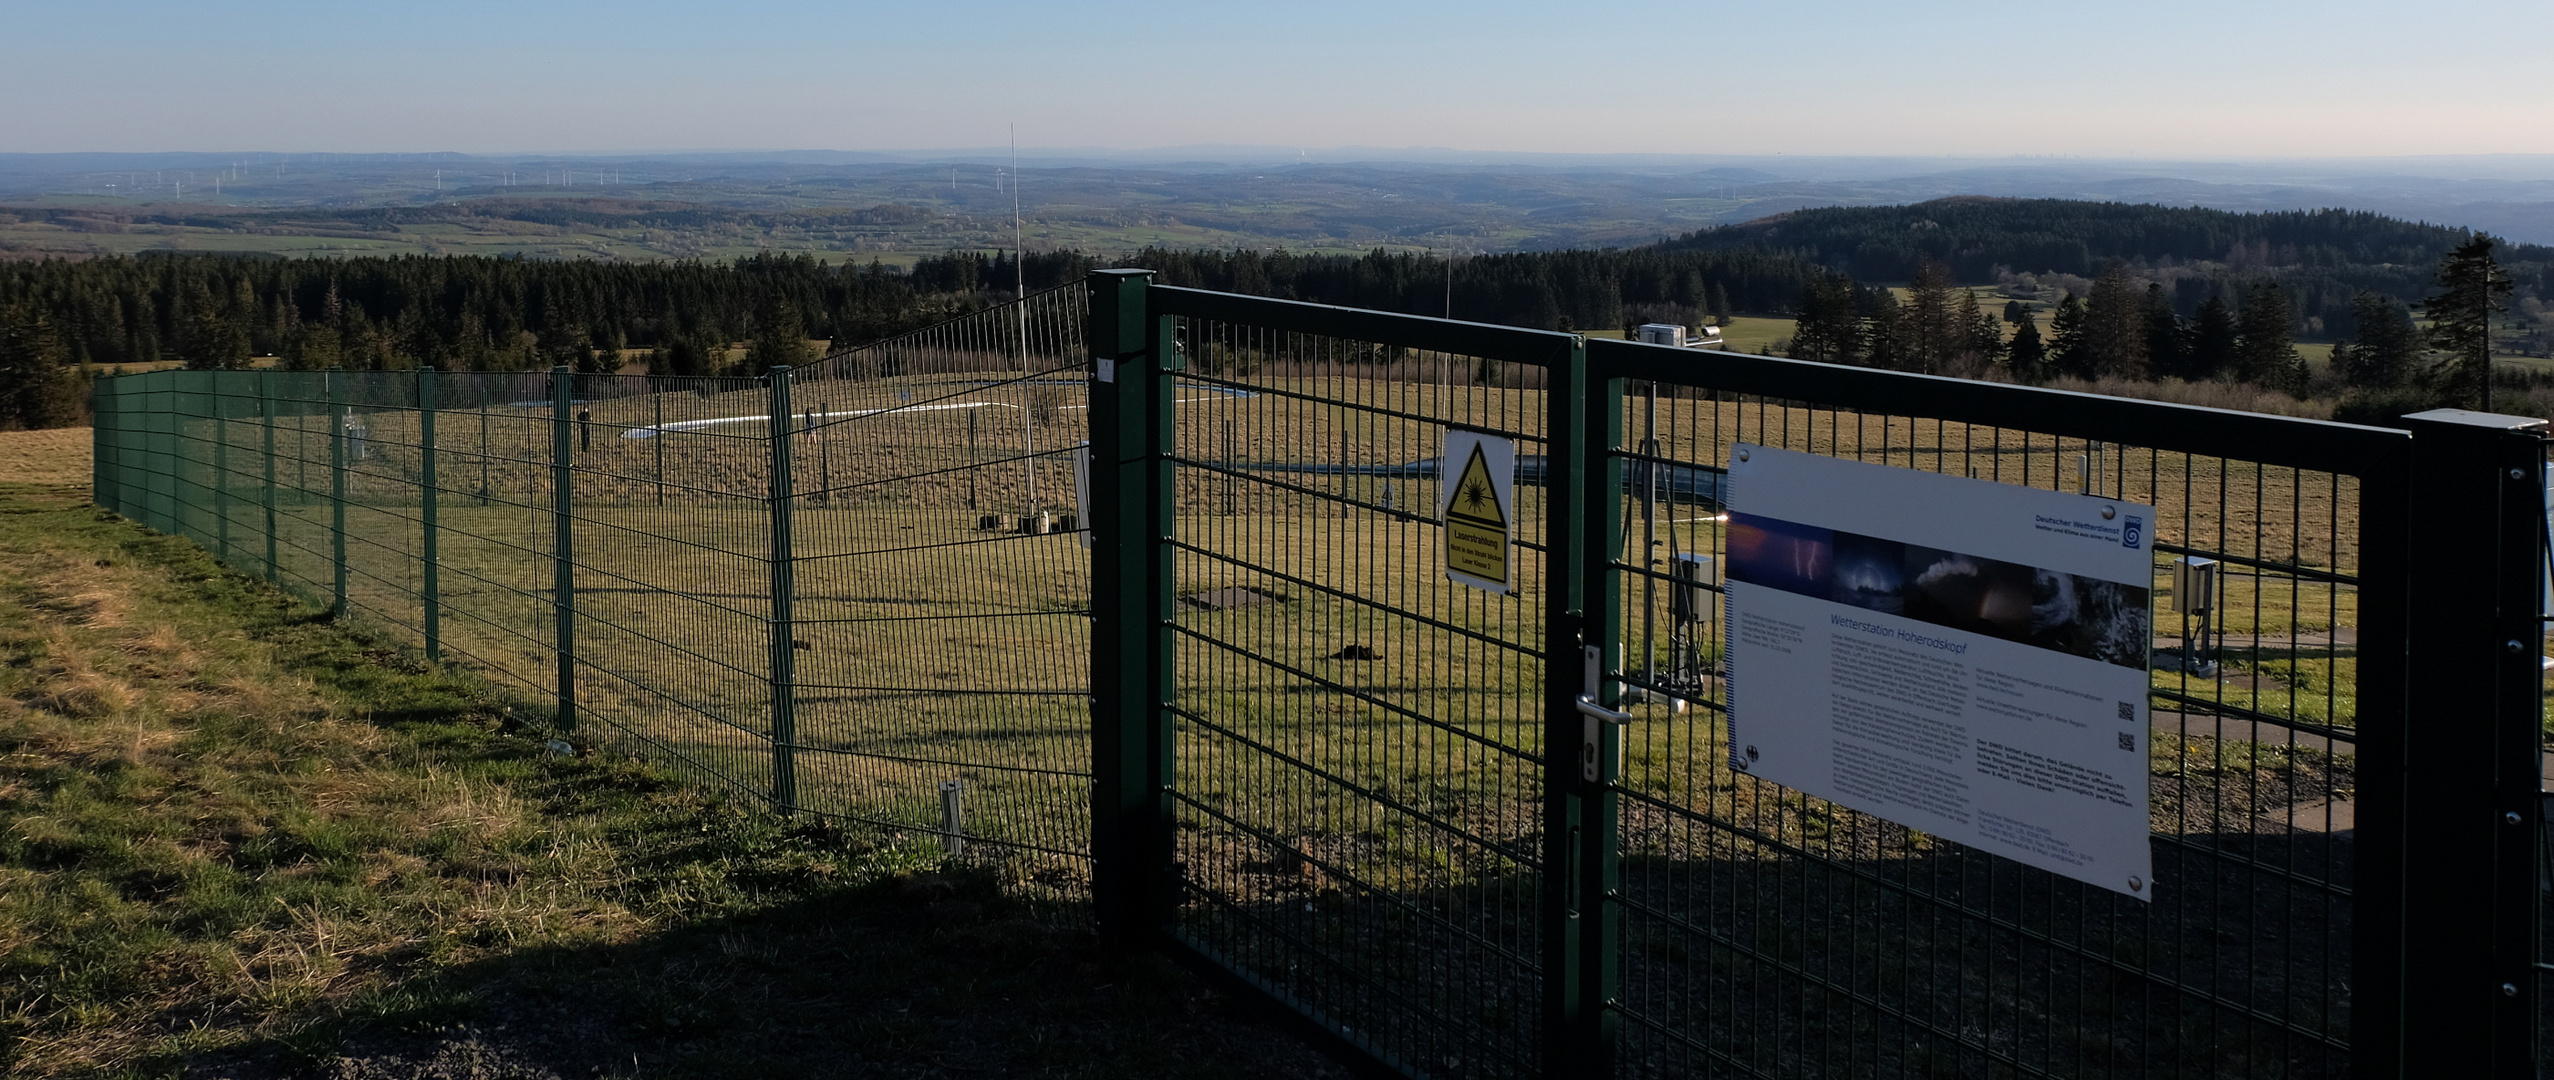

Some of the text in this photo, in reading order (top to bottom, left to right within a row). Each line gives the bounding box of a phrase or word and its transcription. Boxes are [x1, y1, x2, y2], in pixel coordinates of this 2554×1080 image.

[2036, 515, 2120, 534] Deutscher Wetterdienst
[1454, 530, 1498, 550] Laserstrahlung
[1487, 553, 1503, 562] blicken
[1831, 614, 1894, 637] Wetterstation
[1897, 629, 1967, 655] Hoherodskopf
[1977, 746, 2003, 757] betreten.
[2007, 754, 2027, 763] Sollten
[2029, 760, 2045, 768] Ihnen
[2048, 765, 2073, 776] Schäden
[2092, 778, 2126, 790] offensicht-
[1989, 742, 2003, 750] DWD
[2005, 746, 2021, 755] bittet
[2024, 751, 2044, 762] darum,
[2059, 761, 2084, 771] Gelände
[1978, 761, 1998, 770] melden
[2038, 777, 2052, 785] bitte
[2055, 782, 2094, 796] unverzüglich
[2109, 796, 2132, 807] Telefon
[1993, 758, 2023, 770] Störungen
[2034, 769, 2052, 778] dieser
[2055, 775, 2095, 789] DWD-Station
[2097, 787, 2126, 799] auffallen,
[1993, 771, 2010, 780] E-Mail
[2017, 778, 2035, 787] Vielen
[2037, 784, 2054, 792] Dank!
